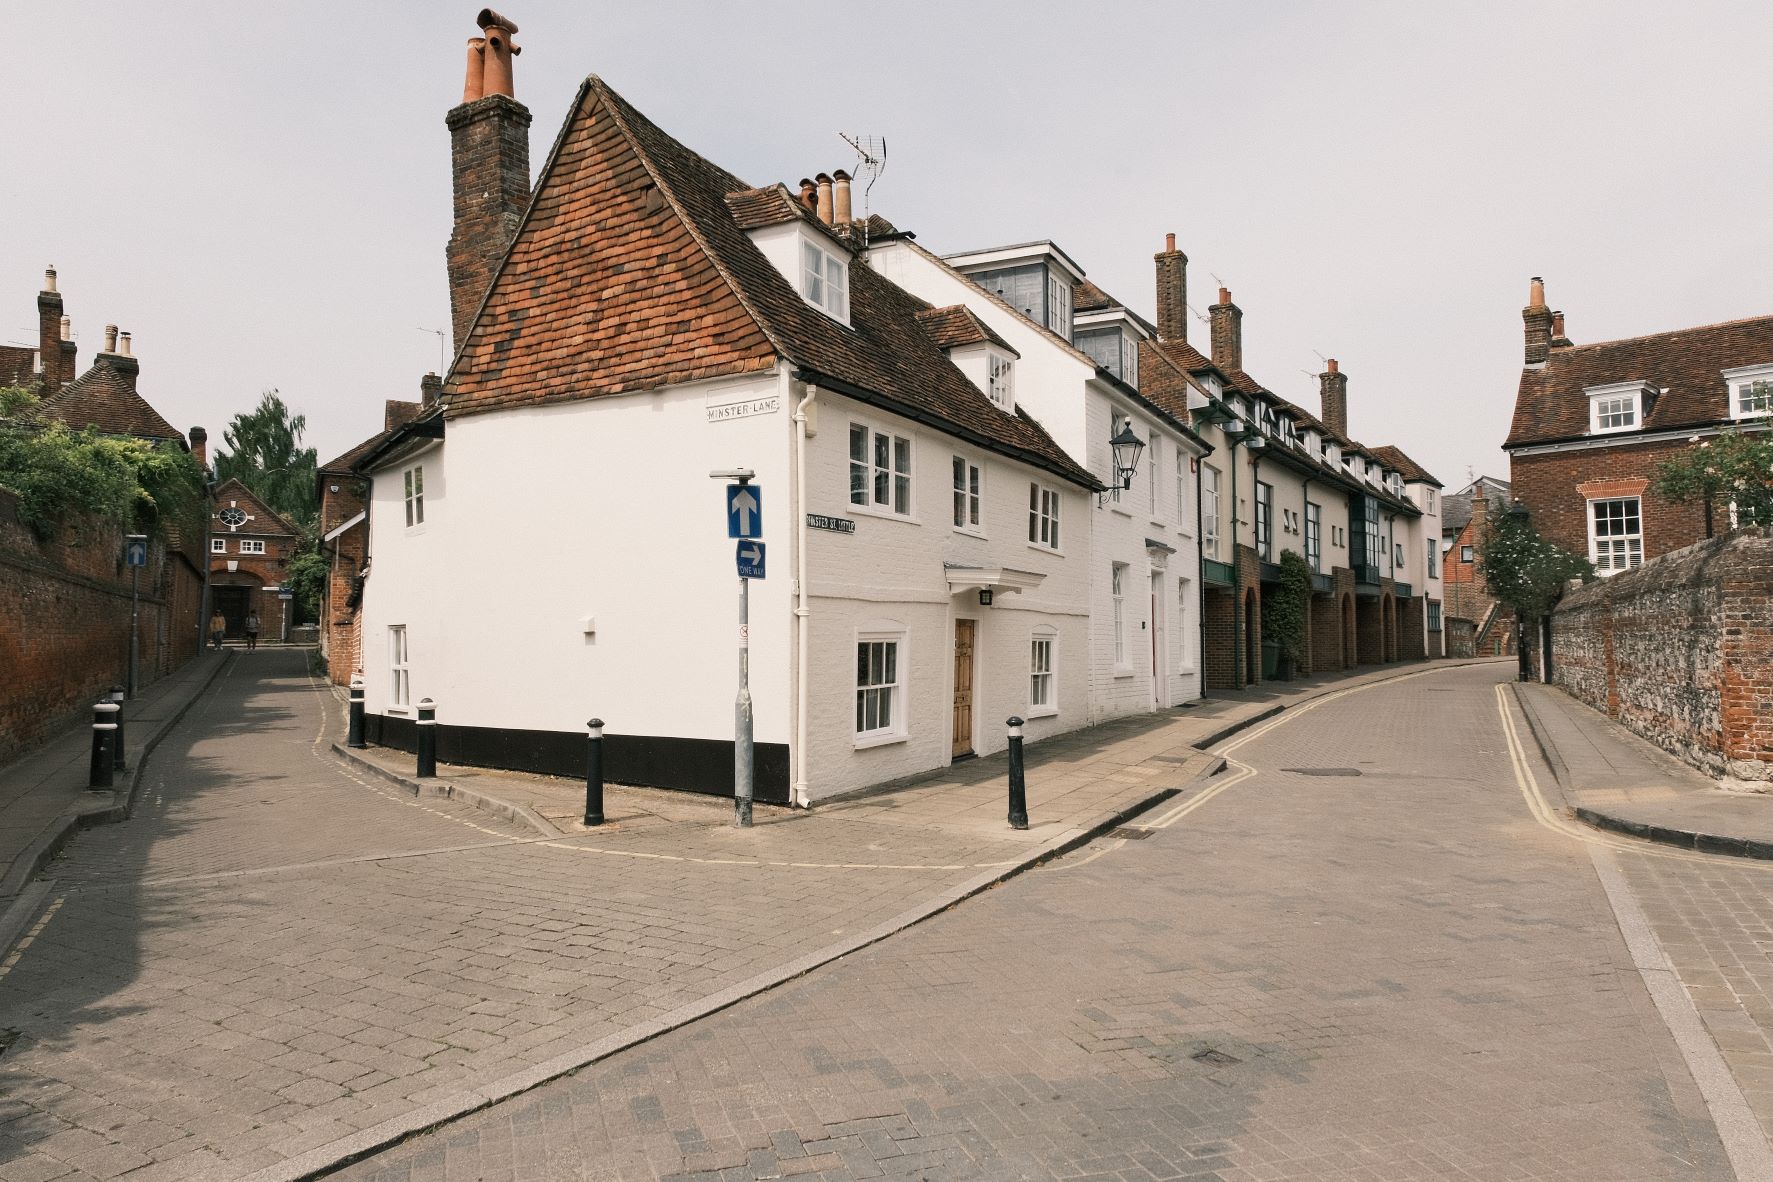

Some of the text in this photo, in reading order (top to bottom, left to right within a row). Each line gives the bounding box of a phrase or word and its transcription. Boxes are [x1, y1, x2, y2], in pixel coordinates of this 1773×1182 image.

[707, 400, 777, 420] MINSTER LANE
[740, 565, 764, 575] ONE WAY
